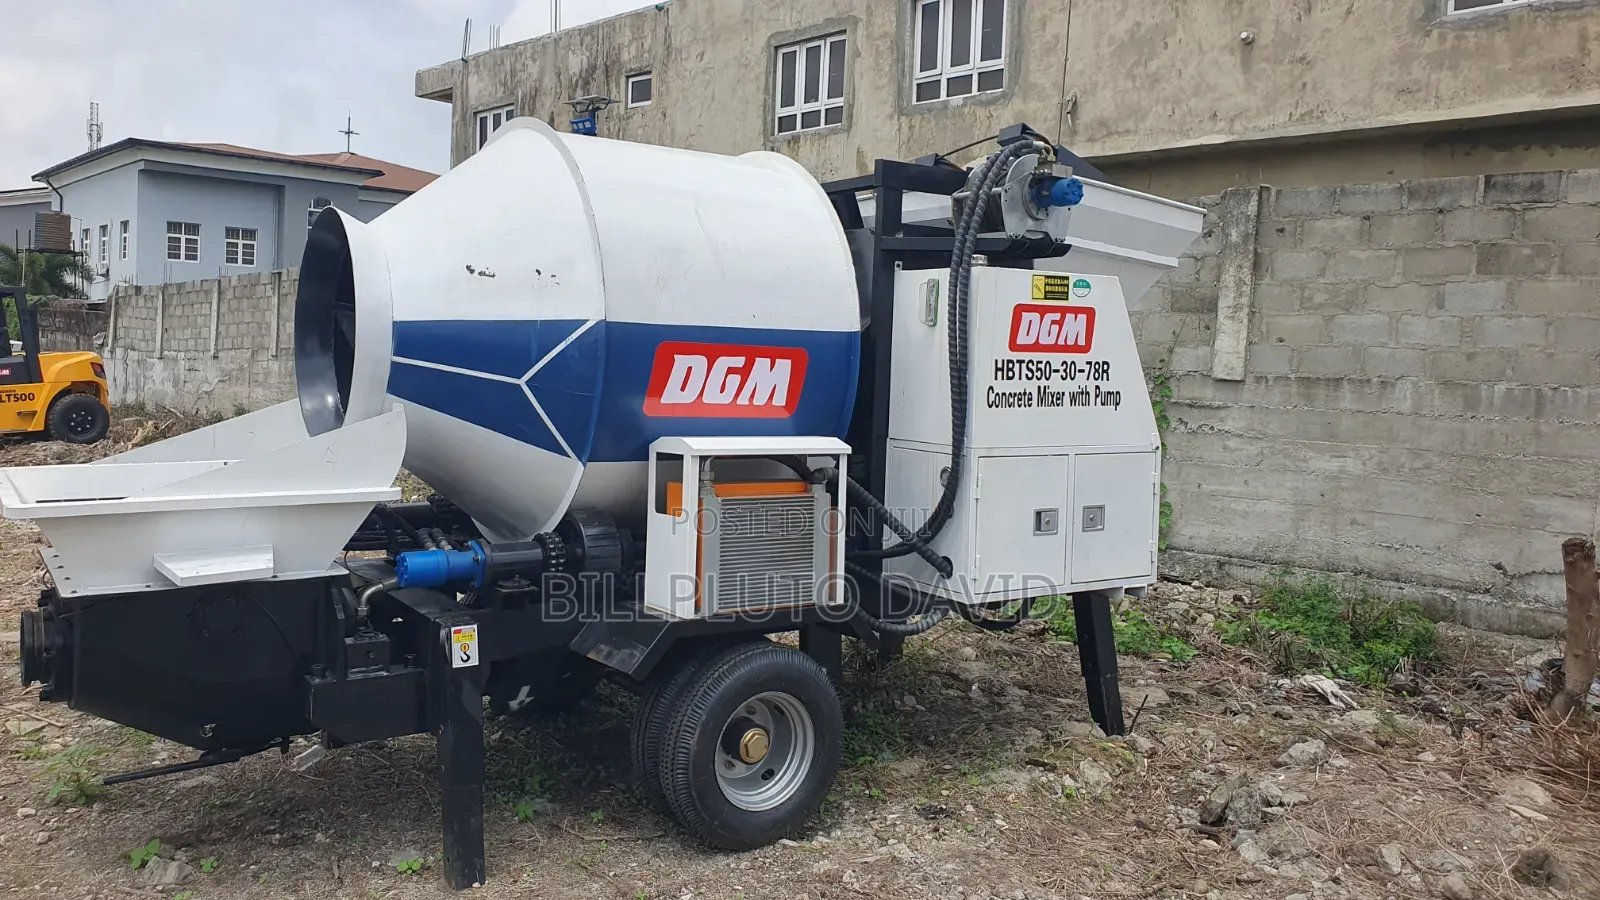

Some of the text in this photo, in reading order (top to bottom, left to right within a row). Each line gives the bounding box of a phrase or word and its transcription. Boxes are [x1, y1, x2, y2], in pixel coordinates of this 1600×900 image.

[1016, 311, 1088, 346] DGM
[660, 354, 792, 407] DGM
[994, 359, 1111, 382] HBTS50-30-78R
[986, 384, 1121, 411] Concrete Mixer with Pump
